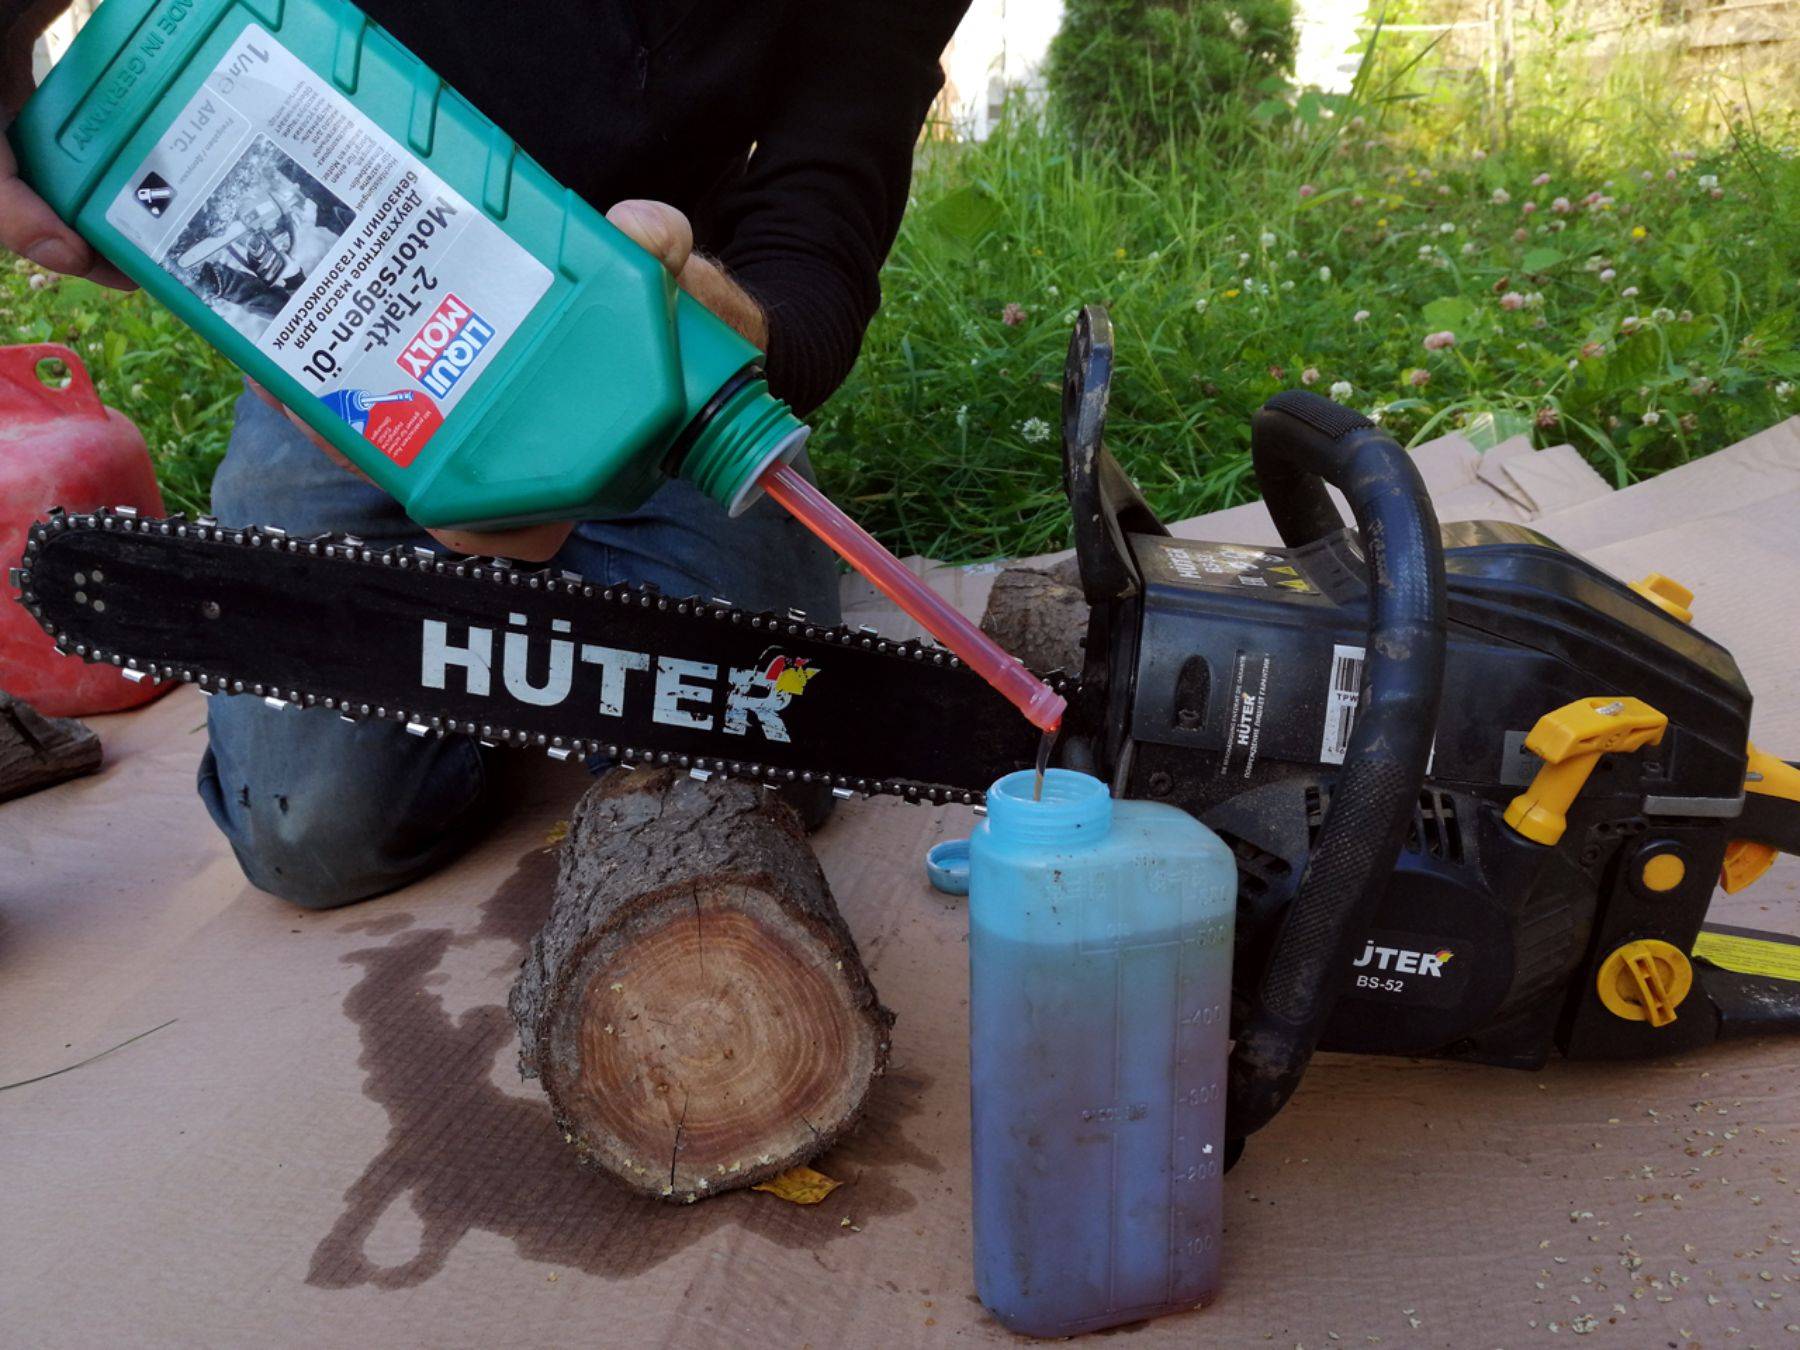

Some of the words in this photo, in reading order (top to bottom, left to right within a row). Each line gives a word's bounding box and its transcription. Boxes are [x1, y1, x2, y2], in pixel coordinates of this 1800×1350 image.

[156, 0, 195, 36] ADE
[138, 30, 165, 58] IN
[67, 55, 149, 152] GERMANY
[188, 99, 218, 131] API
[360, 169, 419, 239] бензопил
[345, 188, 424, 281] Двухтактное
[352, 236, 366, 250] и
[271, 248, 356, 351] газонокосилок
[296, 191, 464, 389] Motorsägen-Öl
[314, 278, 353, 323] масло
[357, 264, 441, 360] 2-Takt-
[290, 319, 320, 351] для
[397, 297, 469, 378] MOLY
[419, 315, 493, 397] LIQUI
[421, 612, 802, 744] HÜTER
[1234, 694, 1255, 744] HÜTER
[1356, 975, 1404, 992] BS-52
[1191, 1003, 1223, 1026] 400
[1189, 1080, 1220, 1106] 300
[1186, 1160, 1217, 1184] 200
[1187, 1234, 1215, 1257] 100
